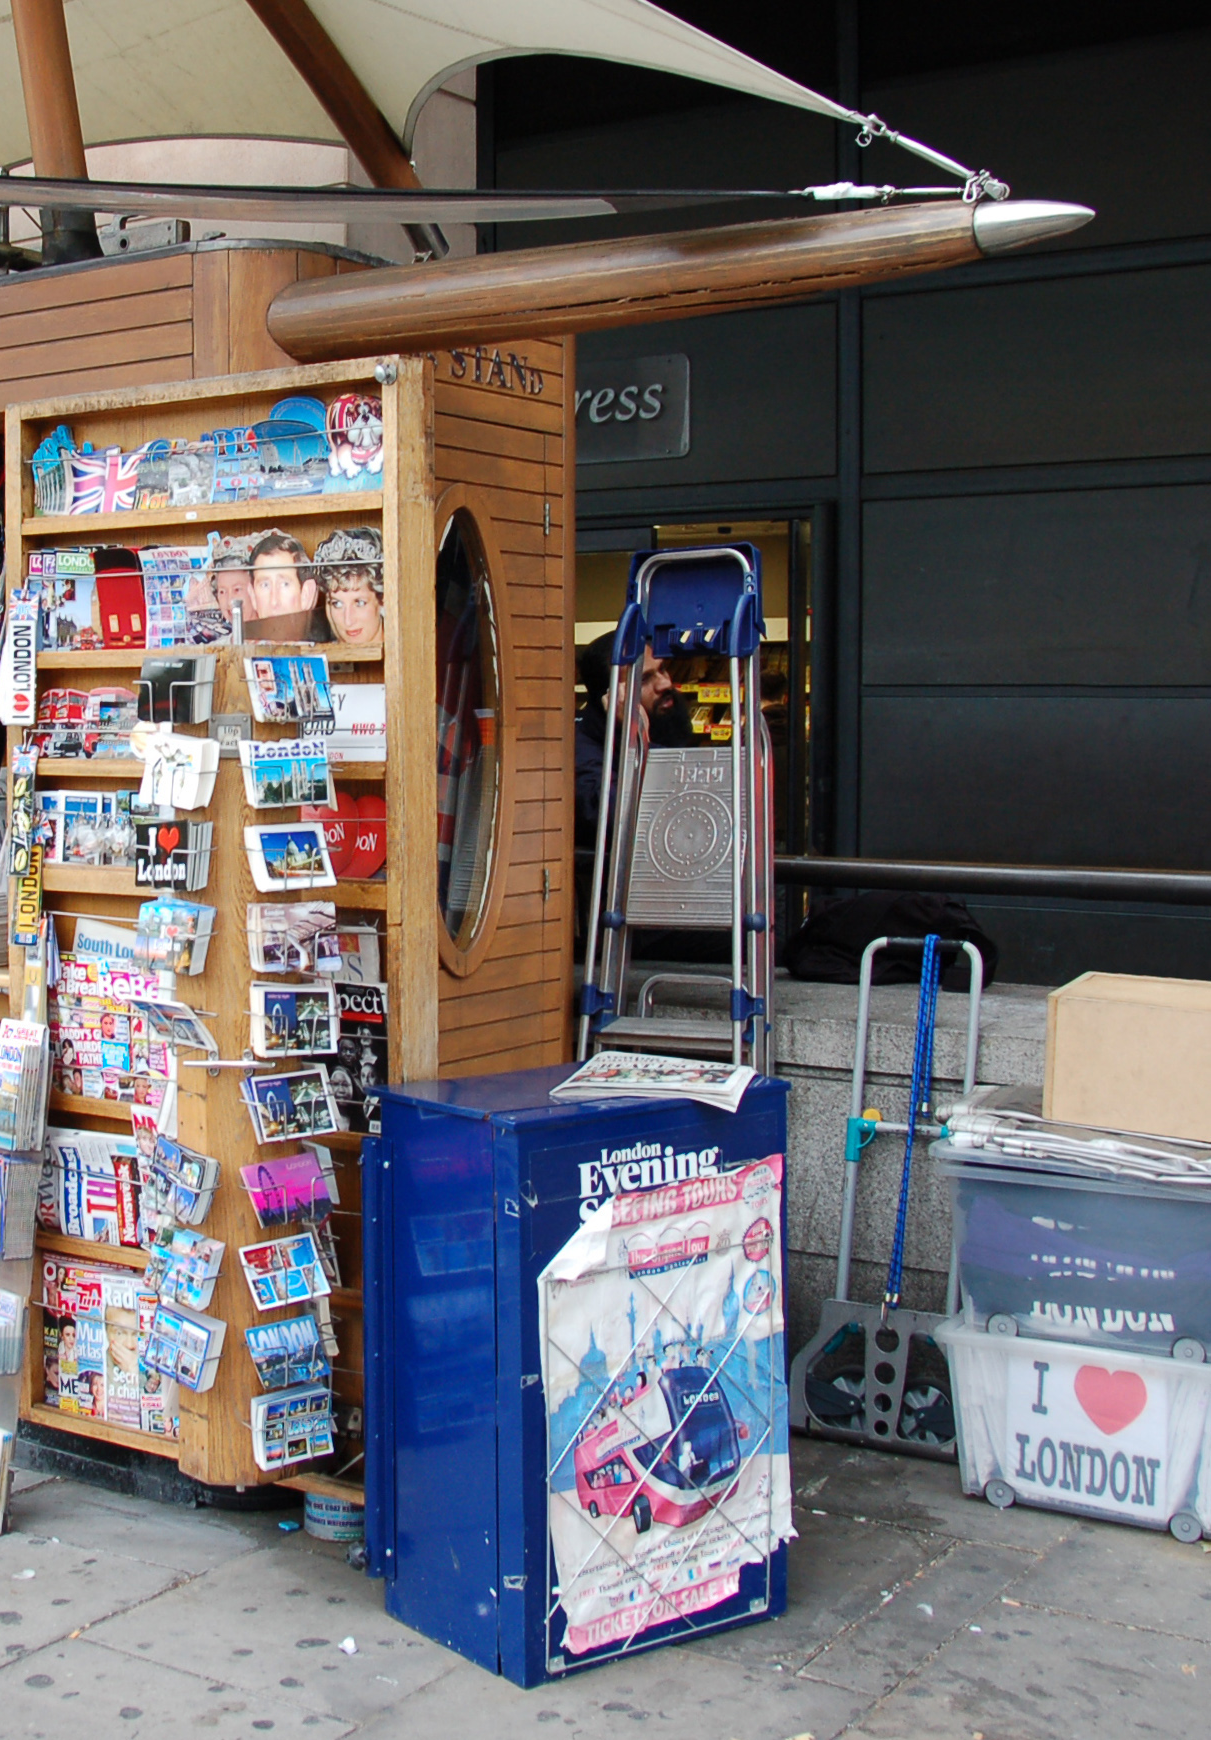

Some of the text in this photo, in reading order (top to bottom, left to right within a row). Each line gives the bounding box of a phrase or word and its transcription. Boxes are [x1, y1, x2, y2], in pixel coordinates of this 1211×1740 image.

[448, 346, 545, 396] STAND
[151, 550, 189, 559] LONDON
[12, 624, 32, 691] LONDON
[221, 727, 239, 736] 10p
[148, 826, 157, 856] I
[19, 850, 40, 930] LONDON
[137, 853, 187, 881] London
[77, 932, 113, 959] South
[577, 1146, 720, 1199] Evening
[601, 1141, 662, 1166] London
[63, 1146, 82, 1237] Broadcast
[119, 1163, 137, 1243] Newsweek
[611, 1175, 739, 1226] SEEING TOURS
[249, 1319, 316, 1354] LONDON
[108, 1386, 115, 1396] a
[1031, 1360, 1050, 1416] I
[1014, 1432, 1162, 1507] LONDON
[587, 1606, 651, 1641] TICKETS
[653, 1599, 677, 1618] ON
[679, 1581, 719, 1607] SALE
